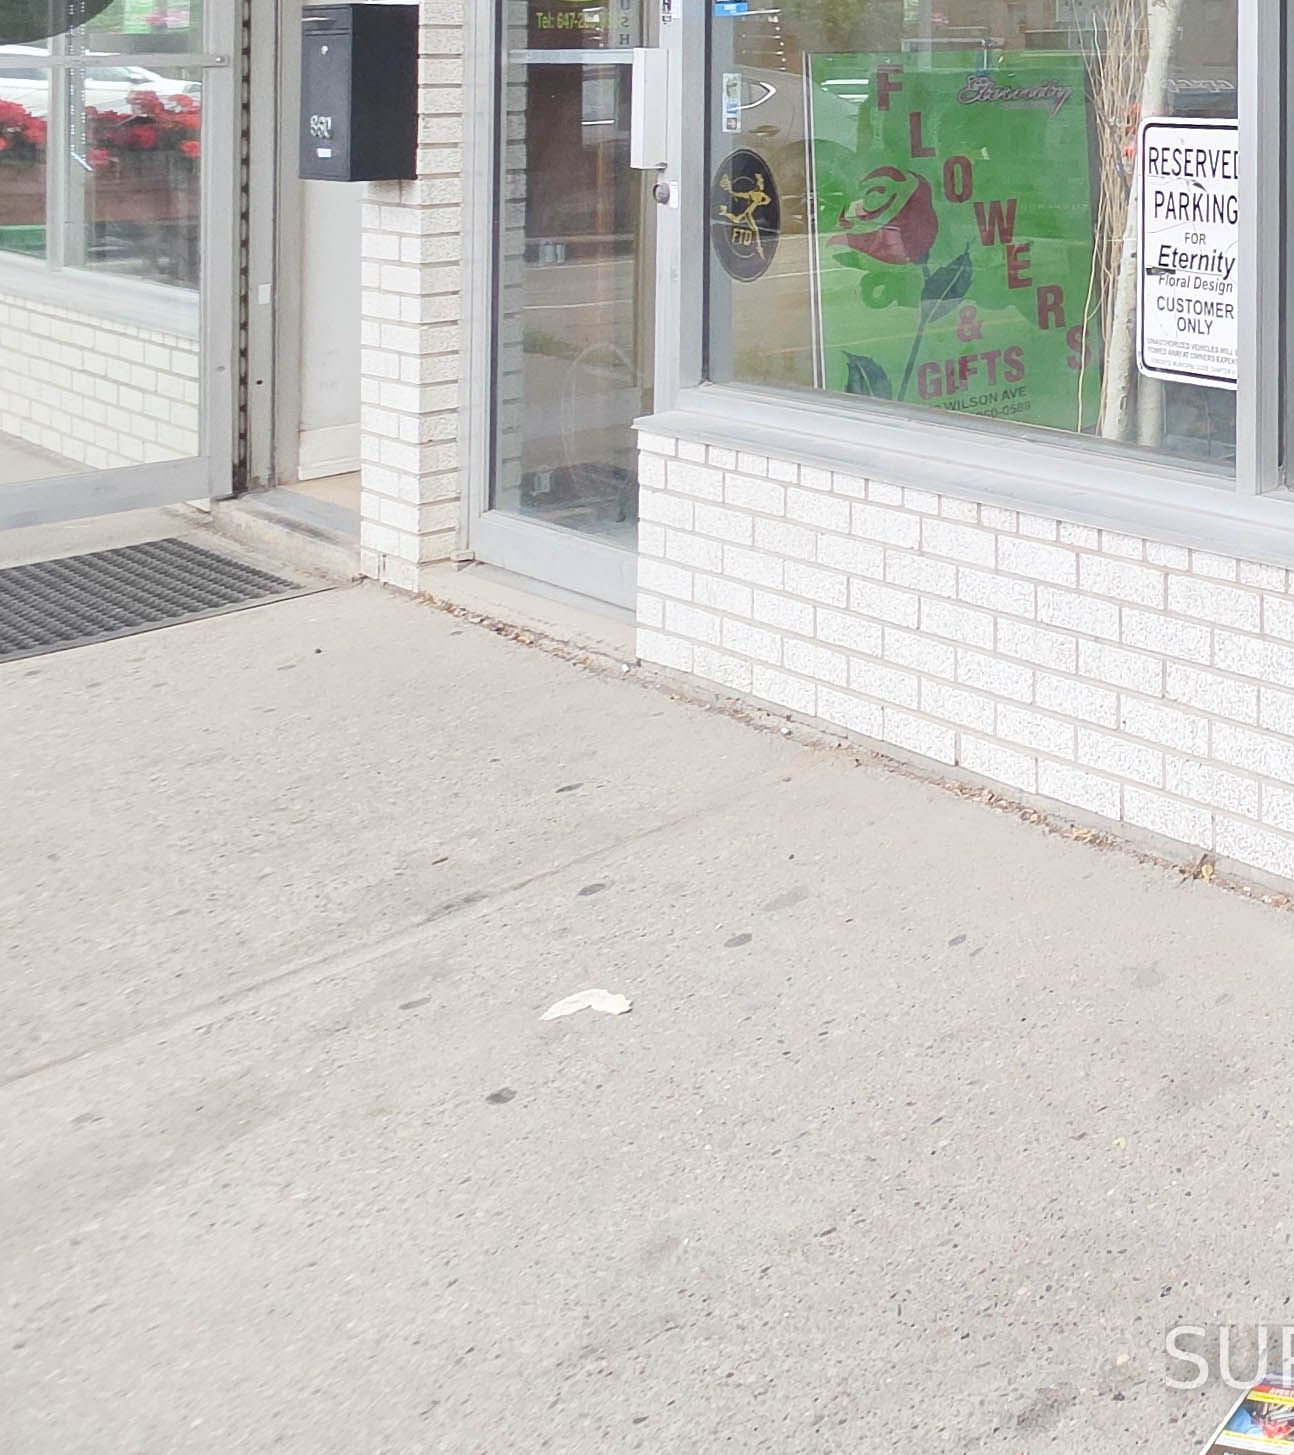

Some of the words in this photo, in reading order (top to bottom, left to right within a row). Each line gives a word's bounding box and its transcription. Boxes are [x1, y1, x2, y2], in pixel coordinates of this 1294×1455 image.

[1154, 190, 1238, 224] PARKING
[732, 228, 752, 245] FTD
[1184, 232, 1206, 245] FOR
[1158, 244, 1236, 280] Eternity
[1158, 274, 1191, 289] Floral
[1193, 276, 1233, 295] Design
[1156, 296, 1234, 320] CUSTOMER
[956, 305, 984, 344] &
[1176, 316, 1214, 335] ONLY
[917, 346, 1025, 401] GIFTS
[943, 392, 999, 412] WILSON
[1001, 385, 1027, 401] AVE
